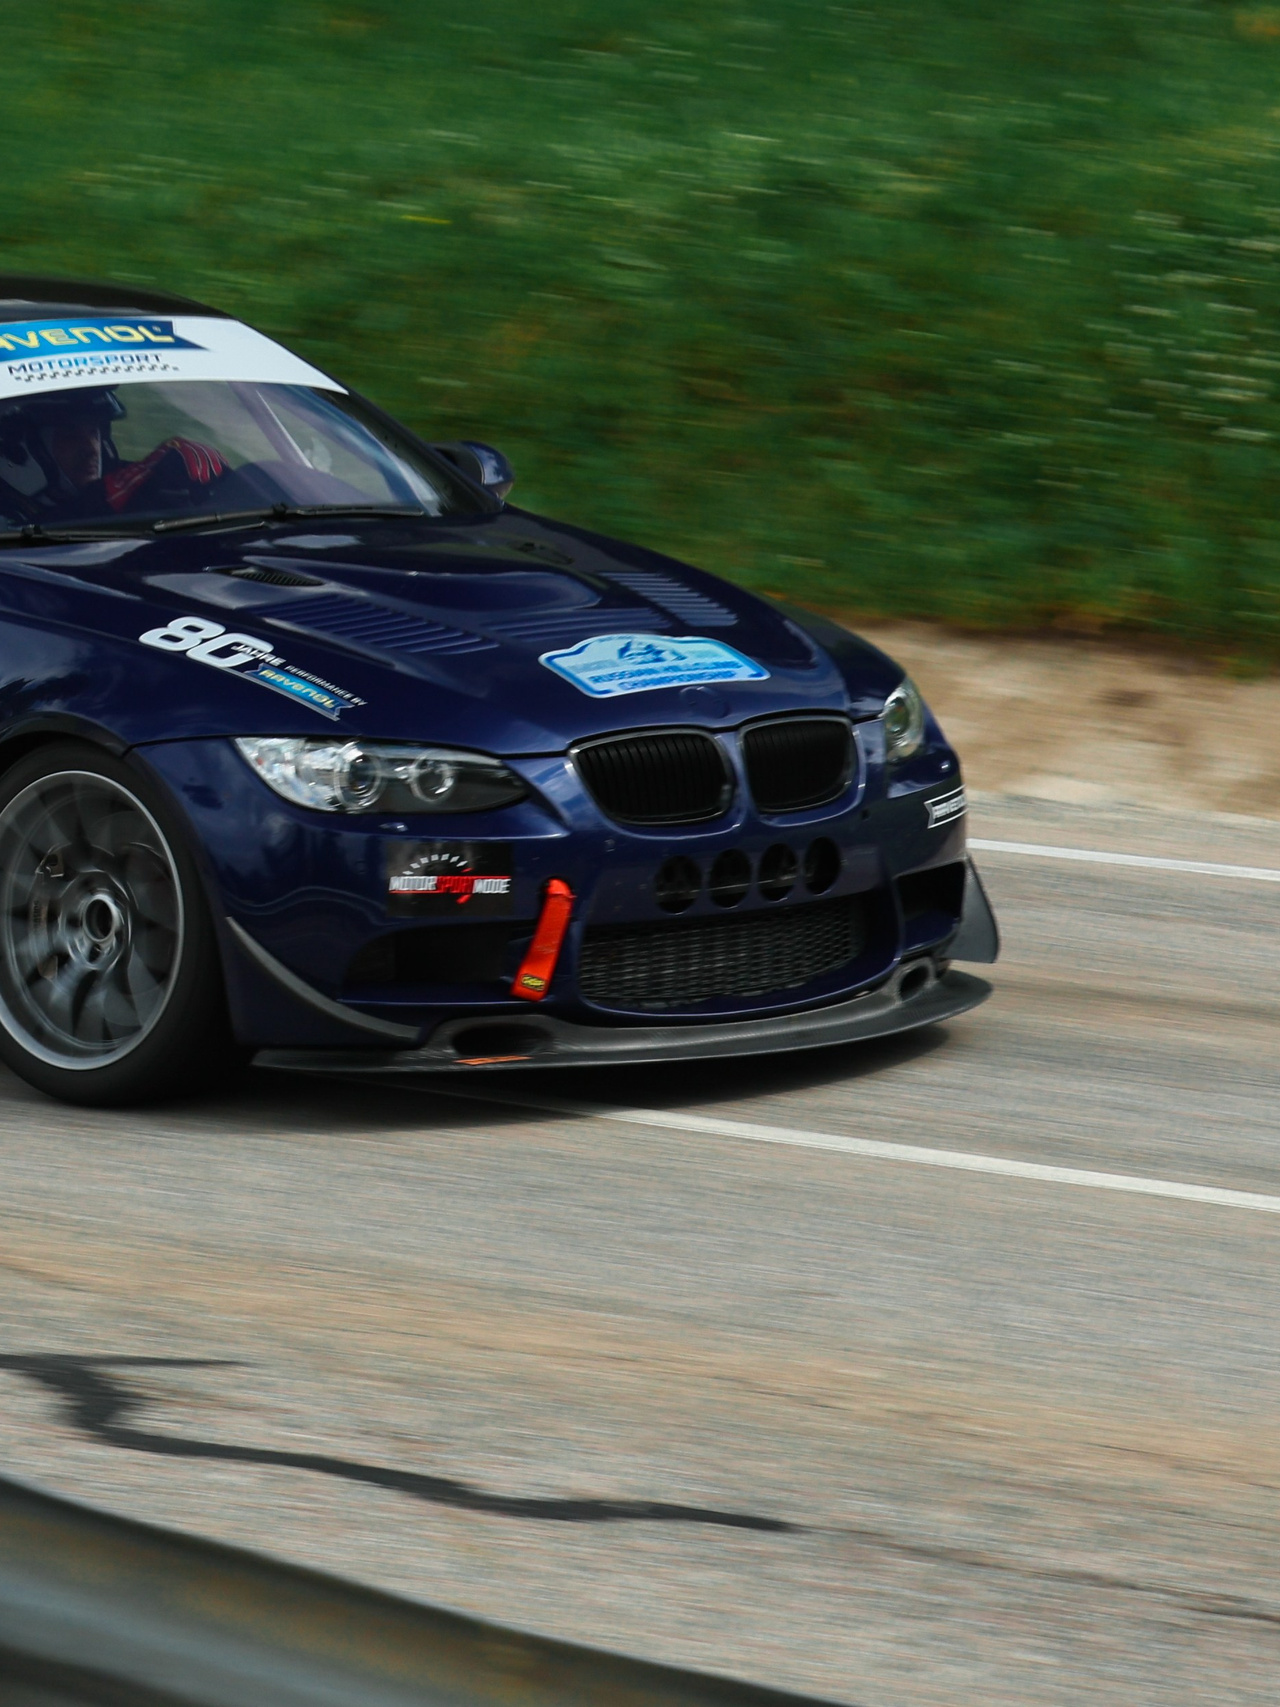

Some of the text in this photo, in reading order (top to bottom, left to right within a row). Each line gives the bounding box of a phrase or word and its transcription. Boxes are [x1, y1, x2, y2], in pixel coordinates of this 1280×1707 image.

[7, 353, 163, 376] MOTORSPORT
[138, 616, 274, 668] 80
[259, 669, 338, 709] RAVENOL
